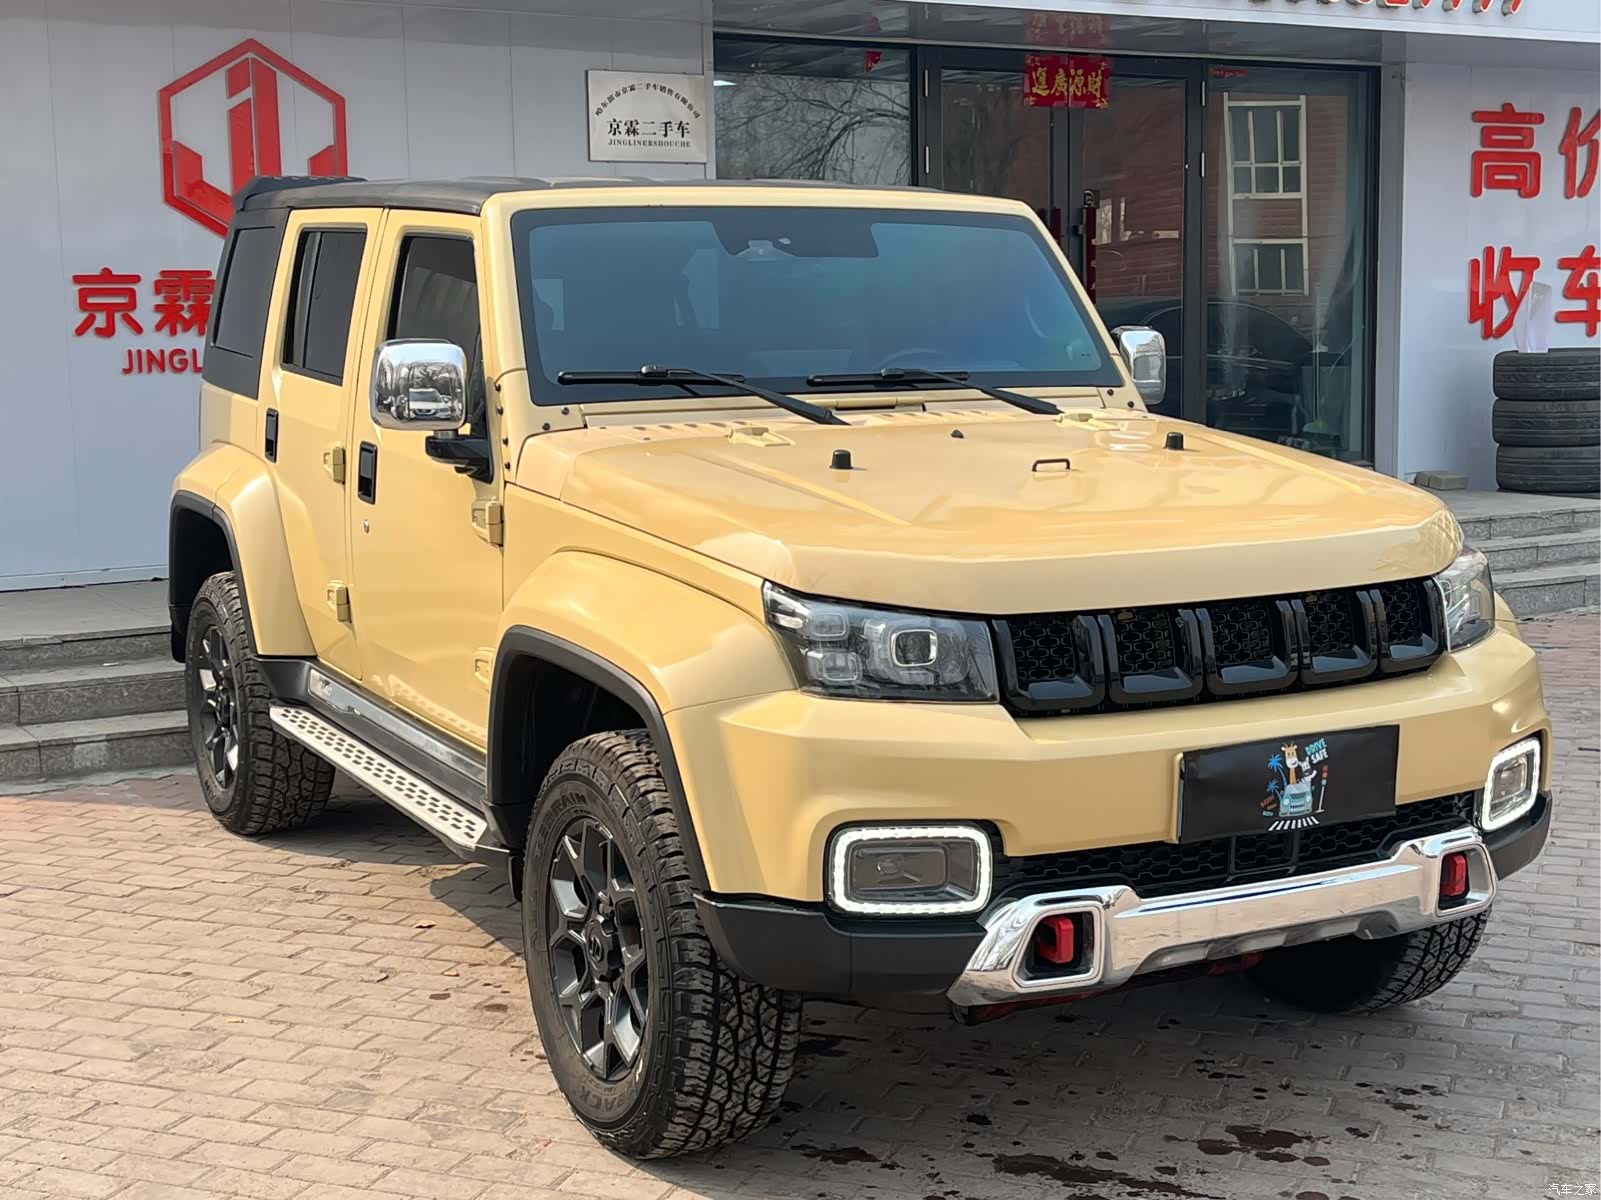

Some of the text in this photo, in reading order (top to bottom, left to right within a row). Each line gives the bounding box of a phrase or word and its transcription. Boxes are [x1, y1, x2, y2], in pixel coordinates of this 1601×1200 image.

[606, 118, 691, 139] 京霖二手车
[72, 267, 215, 338] 京霖
[1305, 739, 1327, 754] DRIVE
[1311, 749, 1328, 763] SAFE
